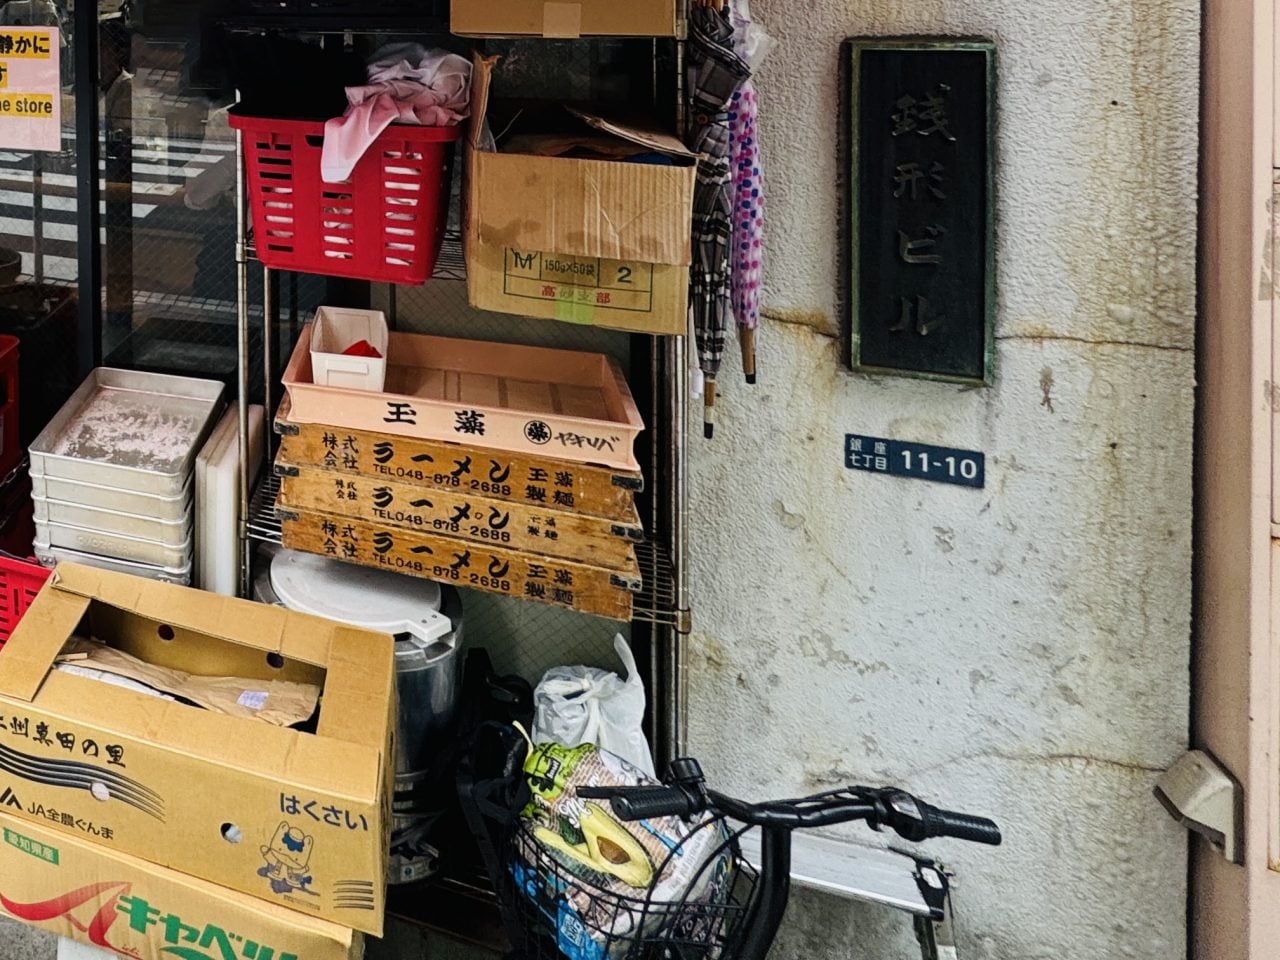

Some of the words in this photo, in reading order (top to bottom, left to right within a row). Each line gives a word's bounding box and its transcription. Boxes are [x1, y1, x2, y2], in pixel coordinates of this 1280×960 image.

[15, 98, 52, 114] store
[617, 266, 632, 283] 2
[373, 441, 511, 483] ラーメン
[849, 437, 888, 455] 銀座
[849, 452, 888, 471] 七丁目
[901, 450, 977, 479] 11-10
[372, 486, 510, 530] ラーメン
[372, 531, 510, 578] ラーメン
[27, 802, 114, 840] JA全農ぐんま
[280, 793, 368, 831] はくさい
[7, 829, 55, 863] 愛知県産
